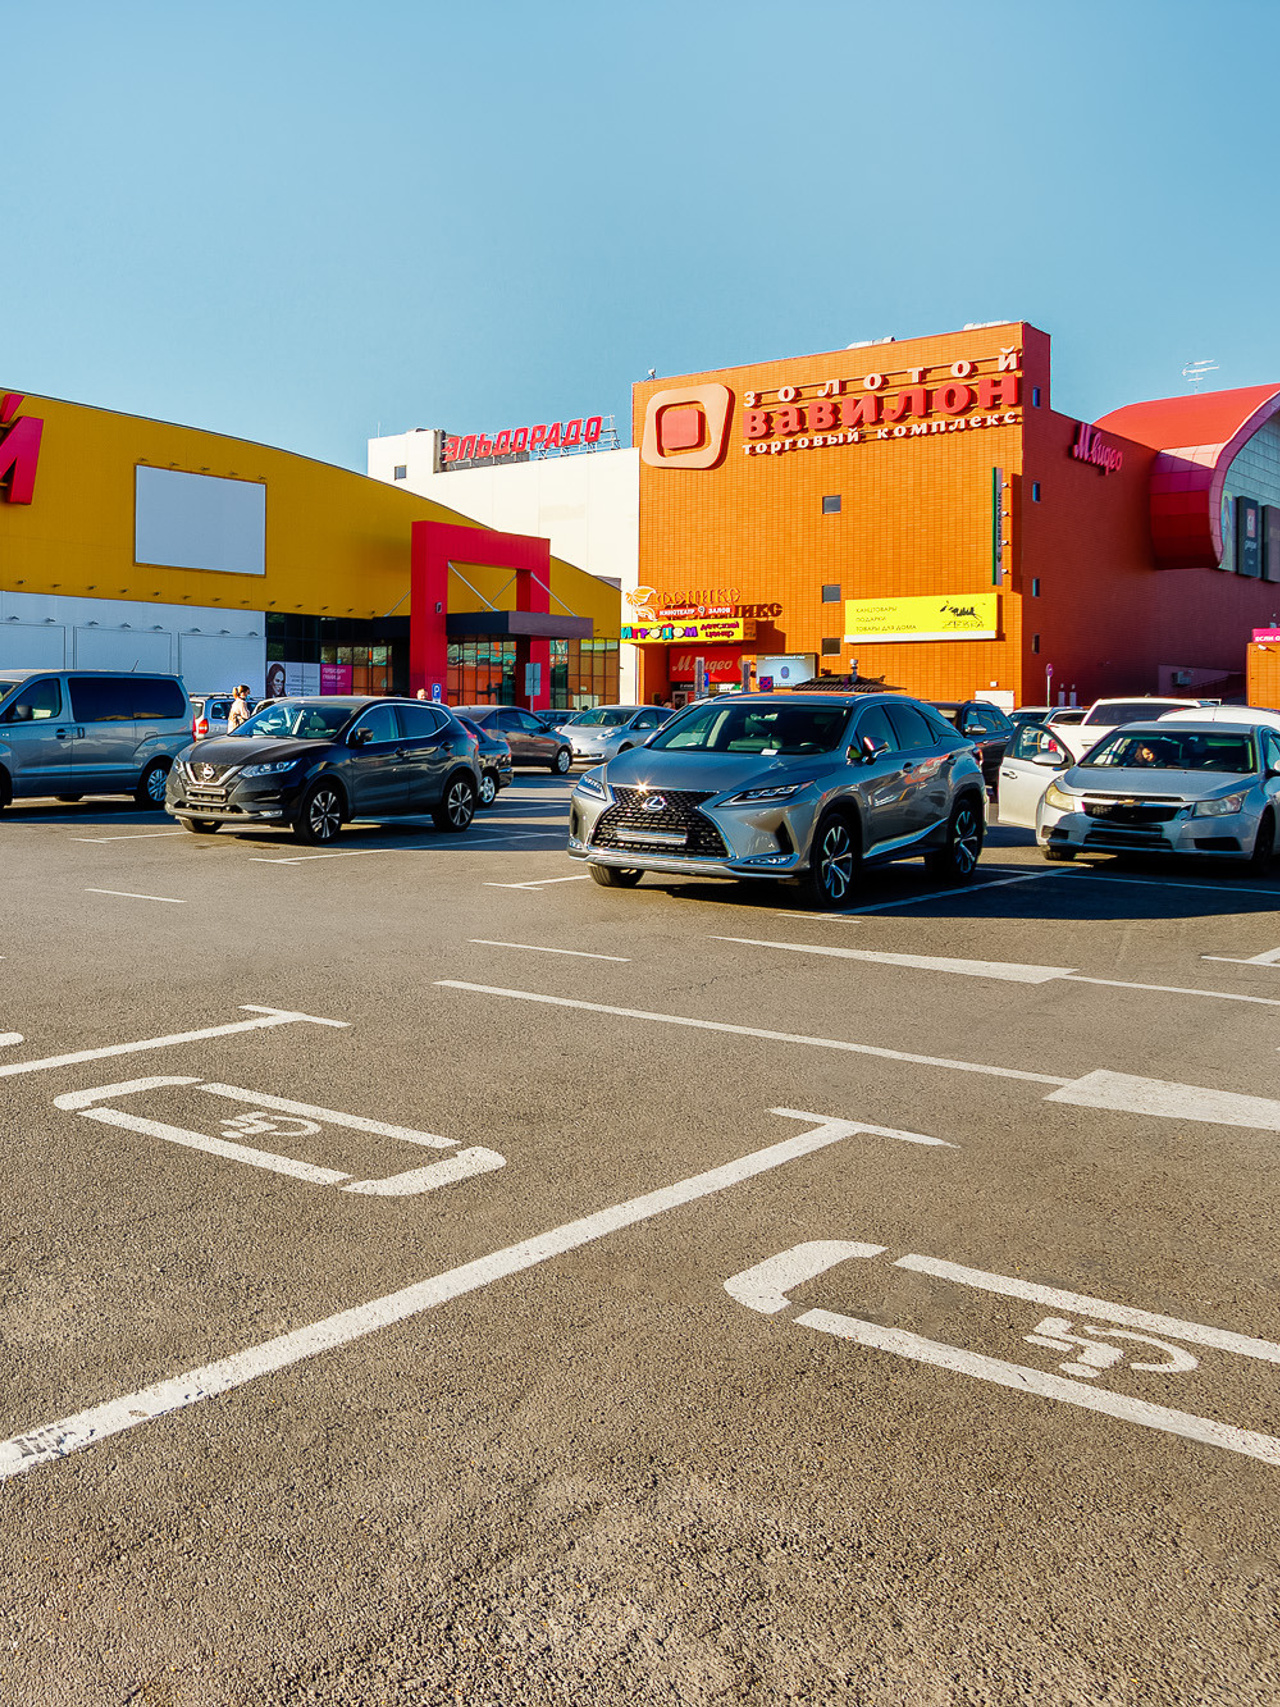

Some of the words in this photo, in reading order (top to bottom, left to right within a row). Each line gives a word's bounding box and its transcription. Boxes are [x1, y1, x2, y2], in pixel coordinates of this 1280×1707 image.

[442, 415, 603, 462] ЭЛЬДОРАДО
[742, 427, 861, 455] торговый
[877, 410, 1018, 440] комплекс
